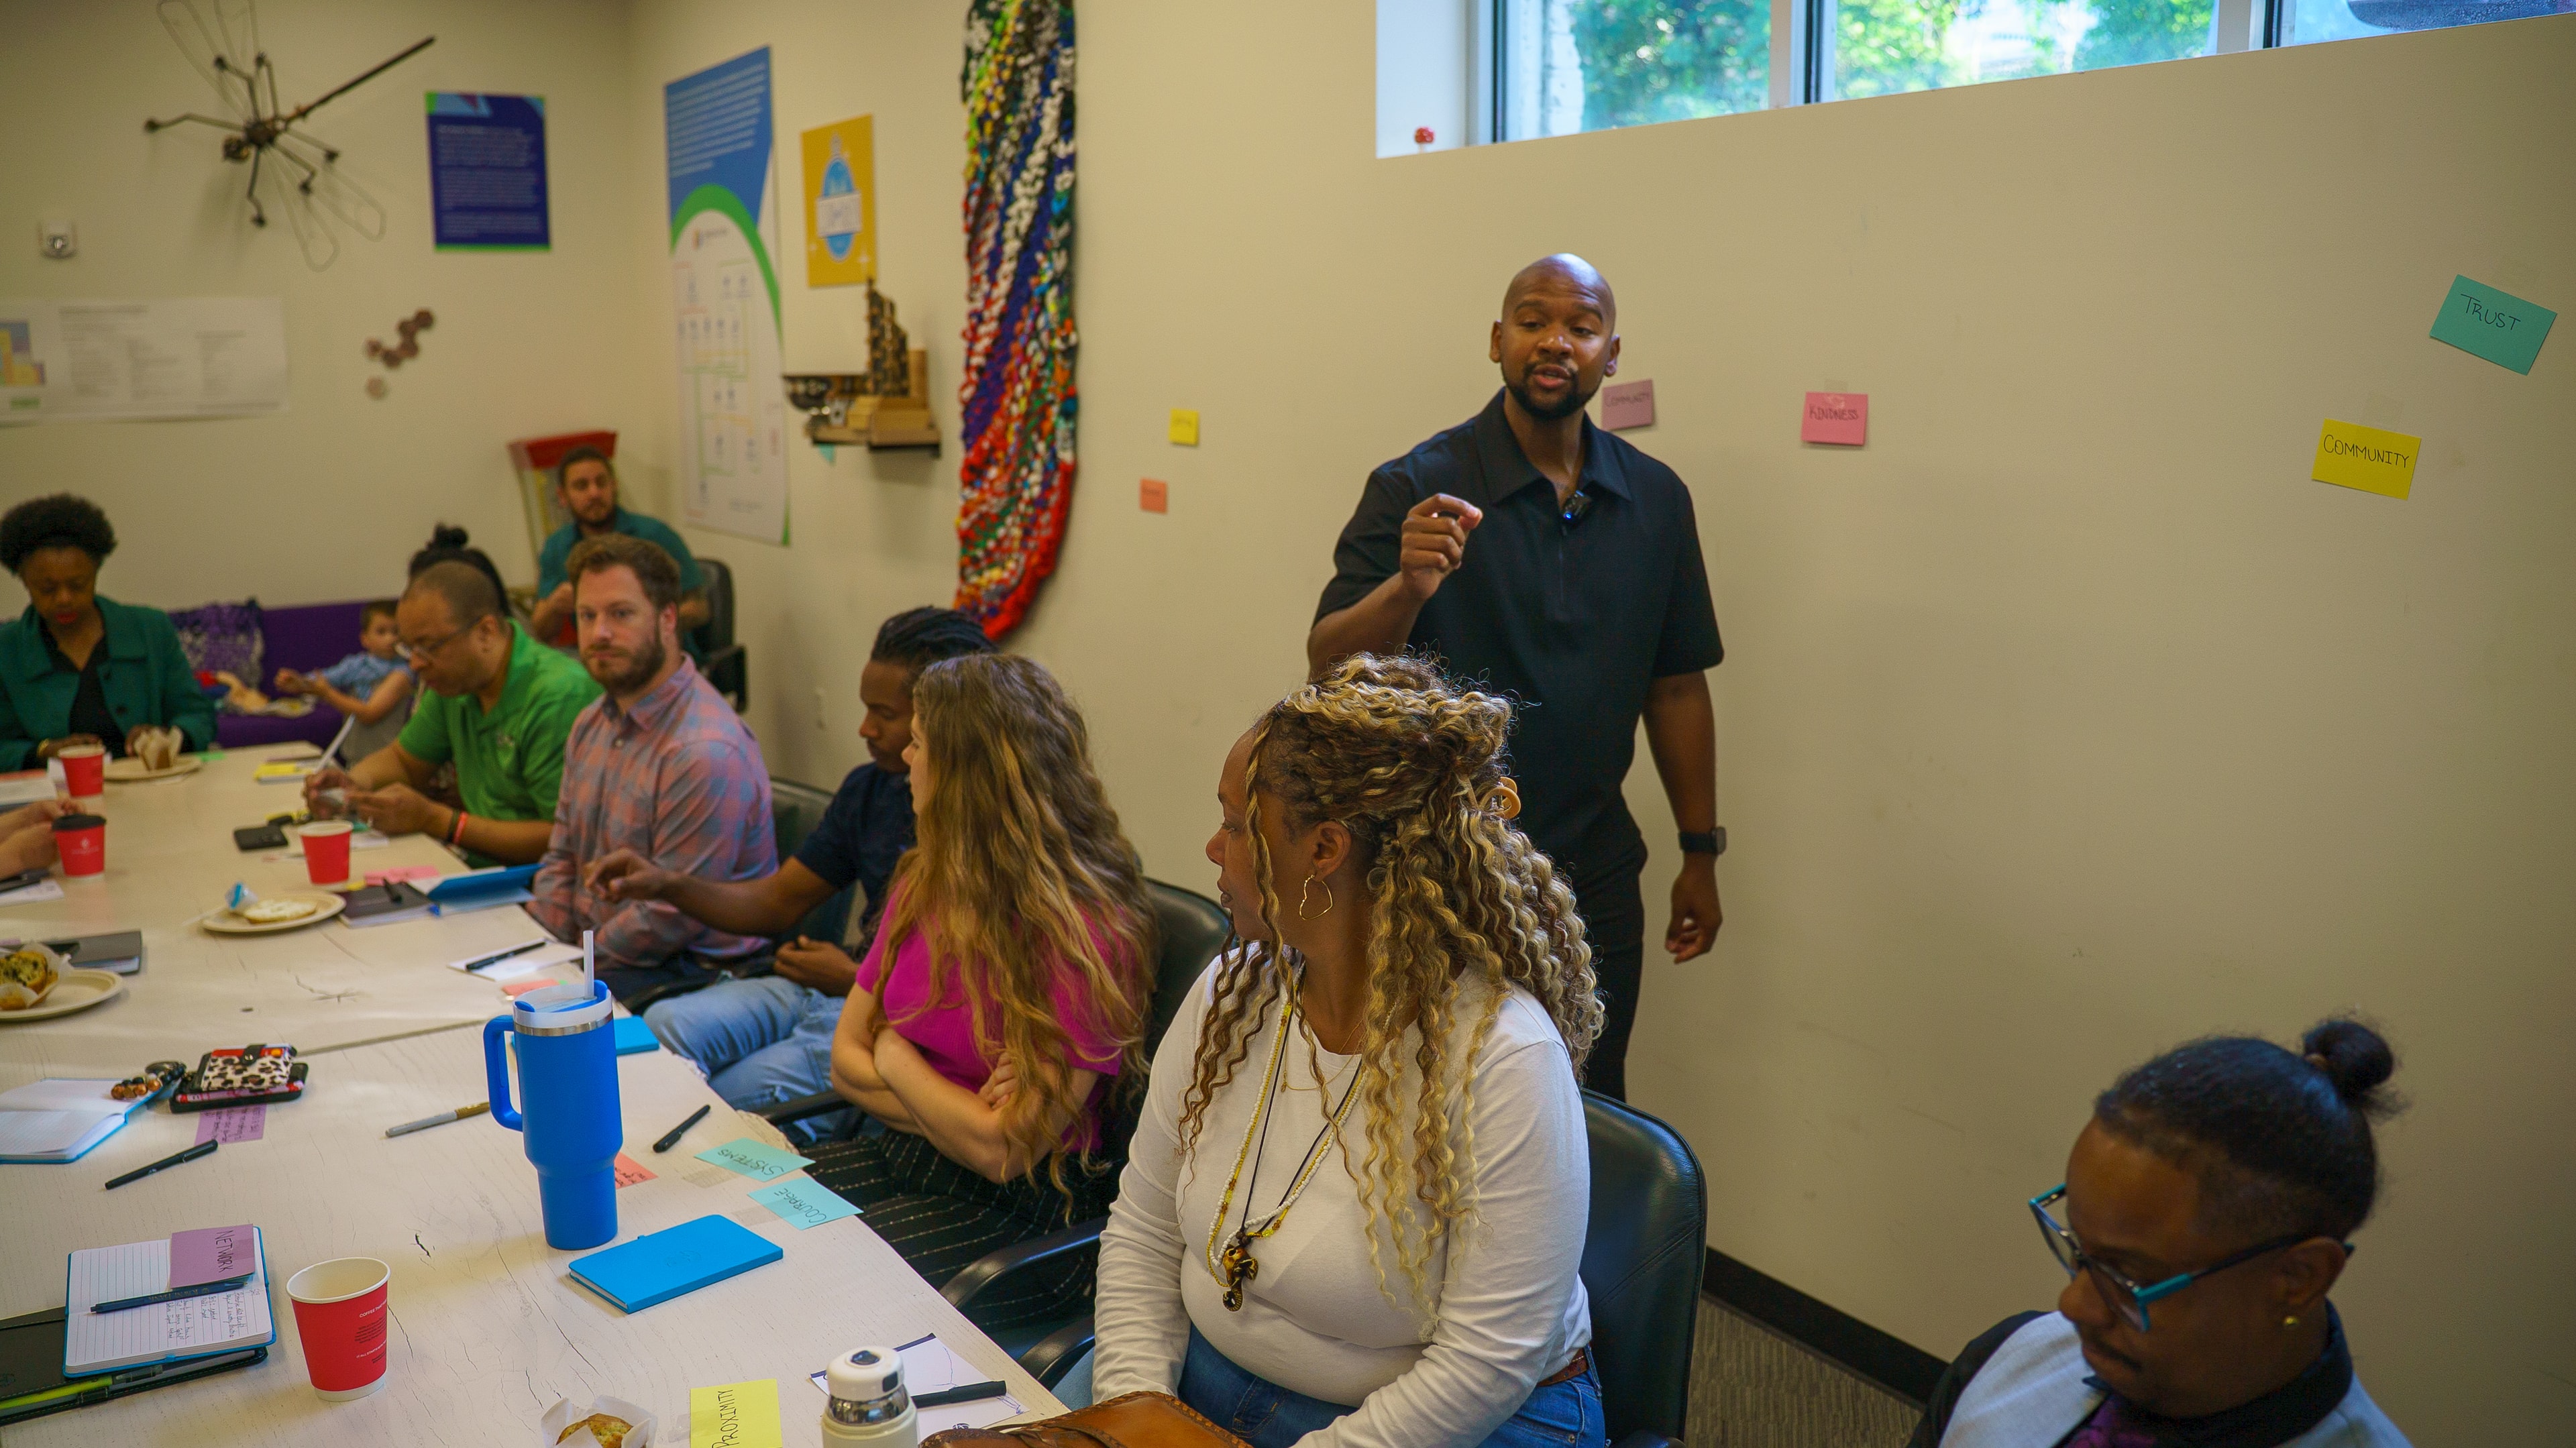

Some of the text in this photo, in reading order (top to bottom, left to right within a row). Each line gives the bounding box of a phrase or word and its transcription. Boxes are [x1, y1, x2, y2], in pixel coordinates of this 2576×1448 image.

[2460, 293, 2521, 331] TRUST
[1809, 404, 1858, 421] KINDNESS
[2323, 434, 2410, 468] COMMUNITY
[717, 1149, 784, 1176] SYSTEMS
[773, 1188, 827, 1223] COURAGE
[215, 1229, 235, 1273] NETWORK
[359, 1308, 375, 1318] COFFEE
[712, 1389, 741, 1448] PROXIMITY
